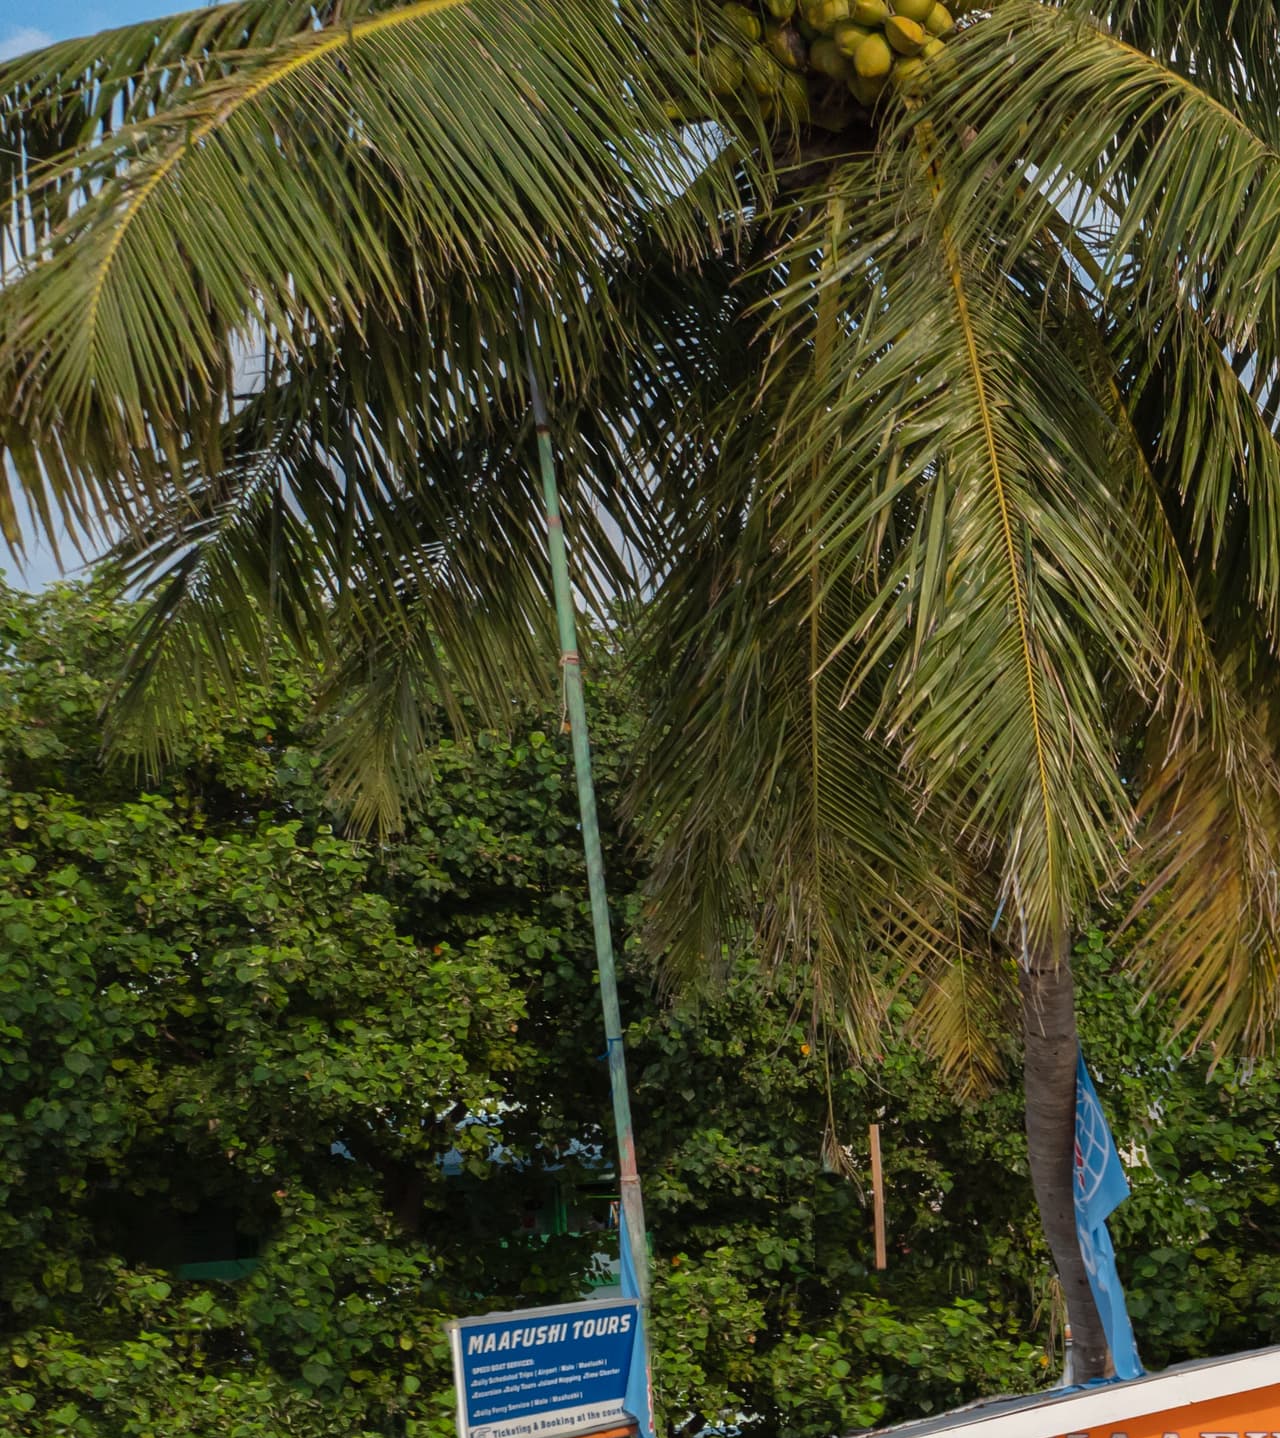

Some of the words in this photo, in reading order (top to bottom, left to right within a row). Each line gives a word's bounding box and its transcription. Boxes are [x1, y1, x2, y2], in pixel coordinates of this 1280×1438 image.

[467, 1322, 568, 1356] MAAFUSHI
[572, 1313, 632, 1340] TOURS
[493, 1423, 532, 1438] Ticketing
